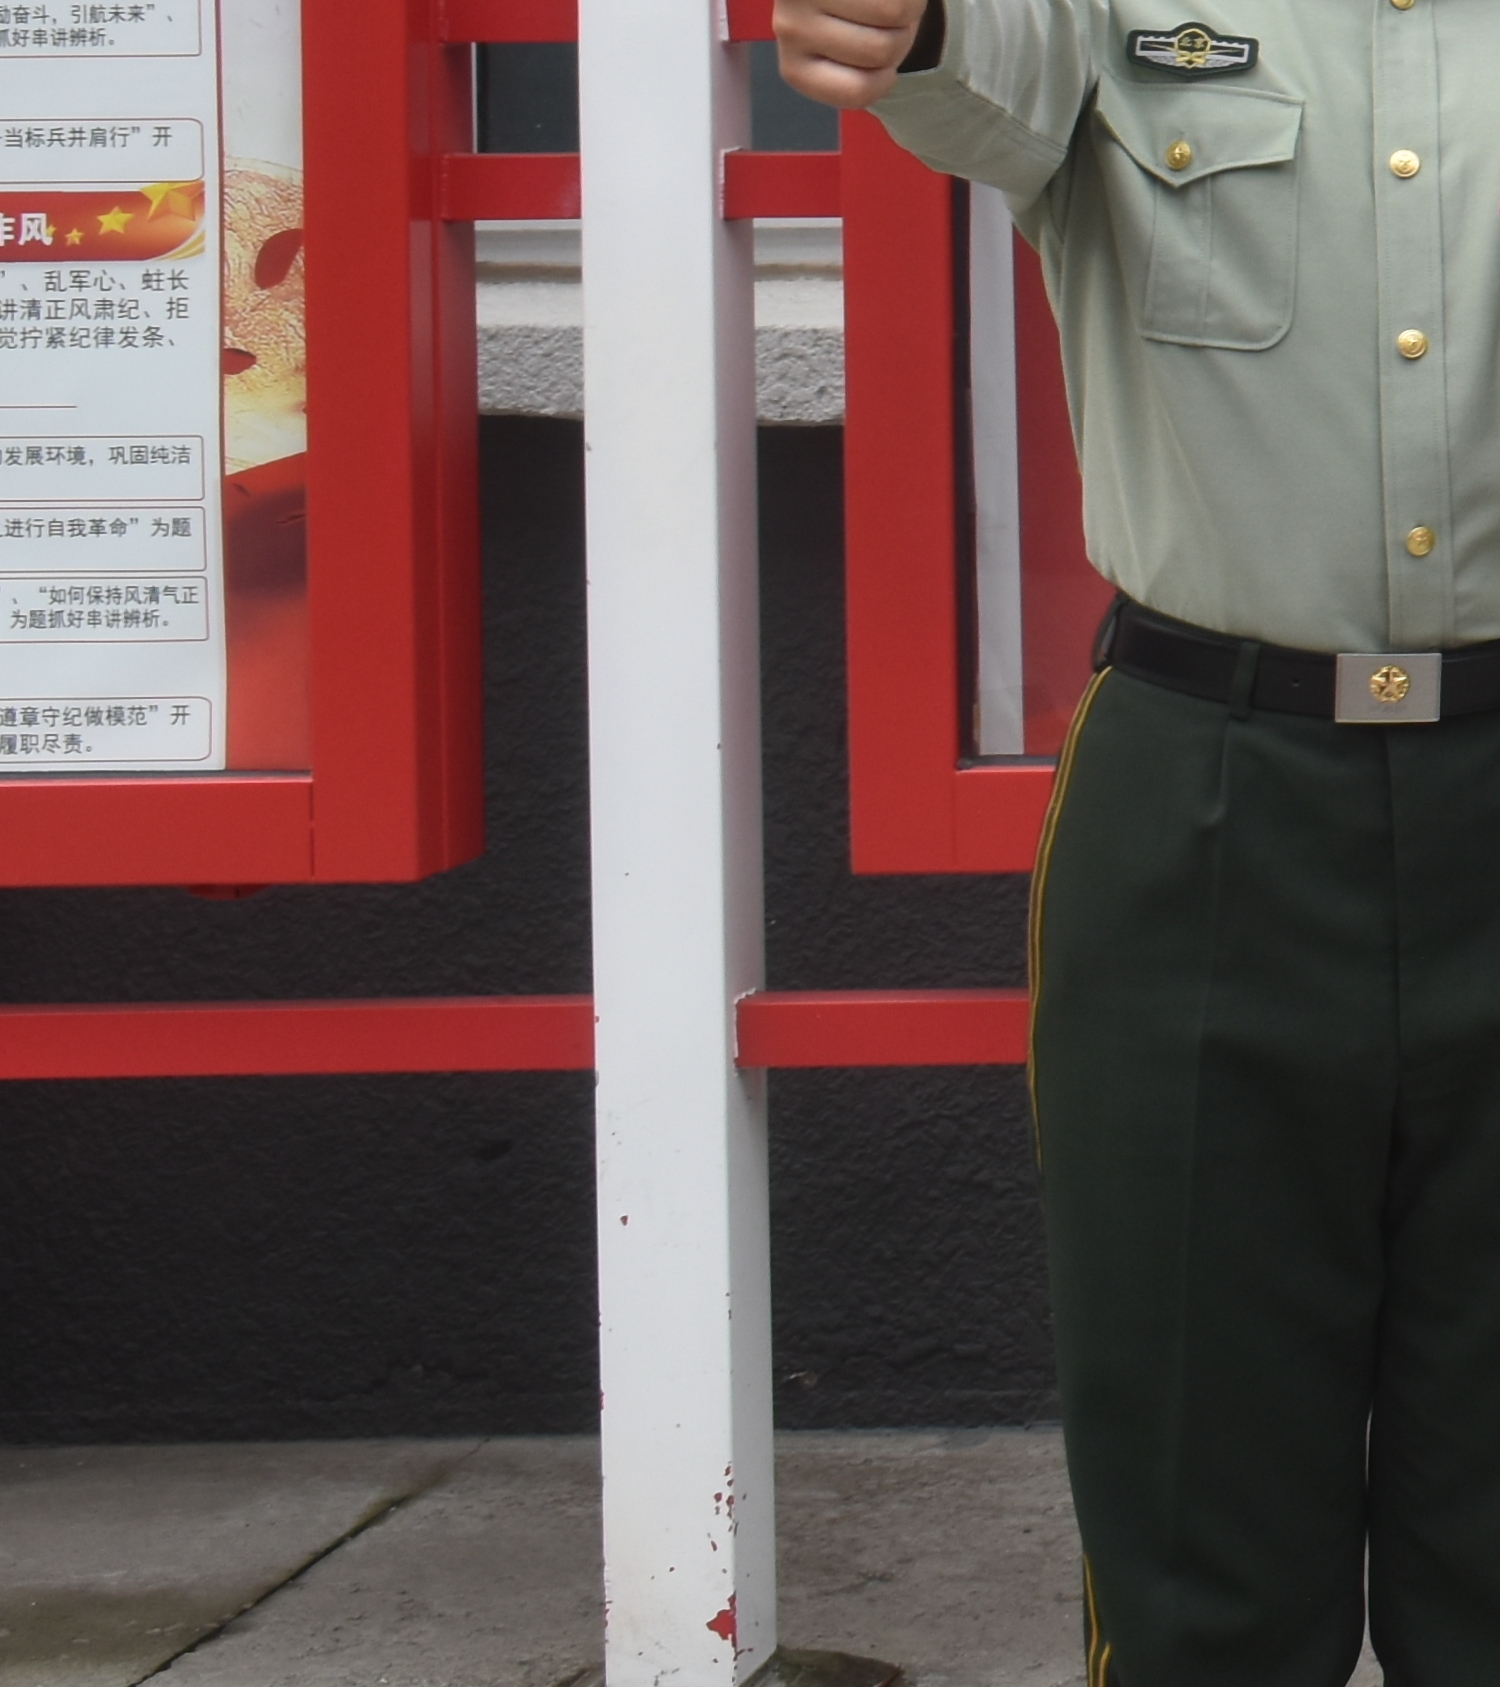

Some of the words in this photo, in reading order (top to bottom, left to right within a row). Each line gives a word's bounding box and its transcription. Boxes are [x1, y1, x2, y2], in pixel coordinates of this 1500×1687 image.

[0, 126, 173, 148] 当标兵并肩行”开
[0, 445, 192, 466] 发展环境，巩固纯洁
[0, 517, 192, 538] 进行自我革命”为题
